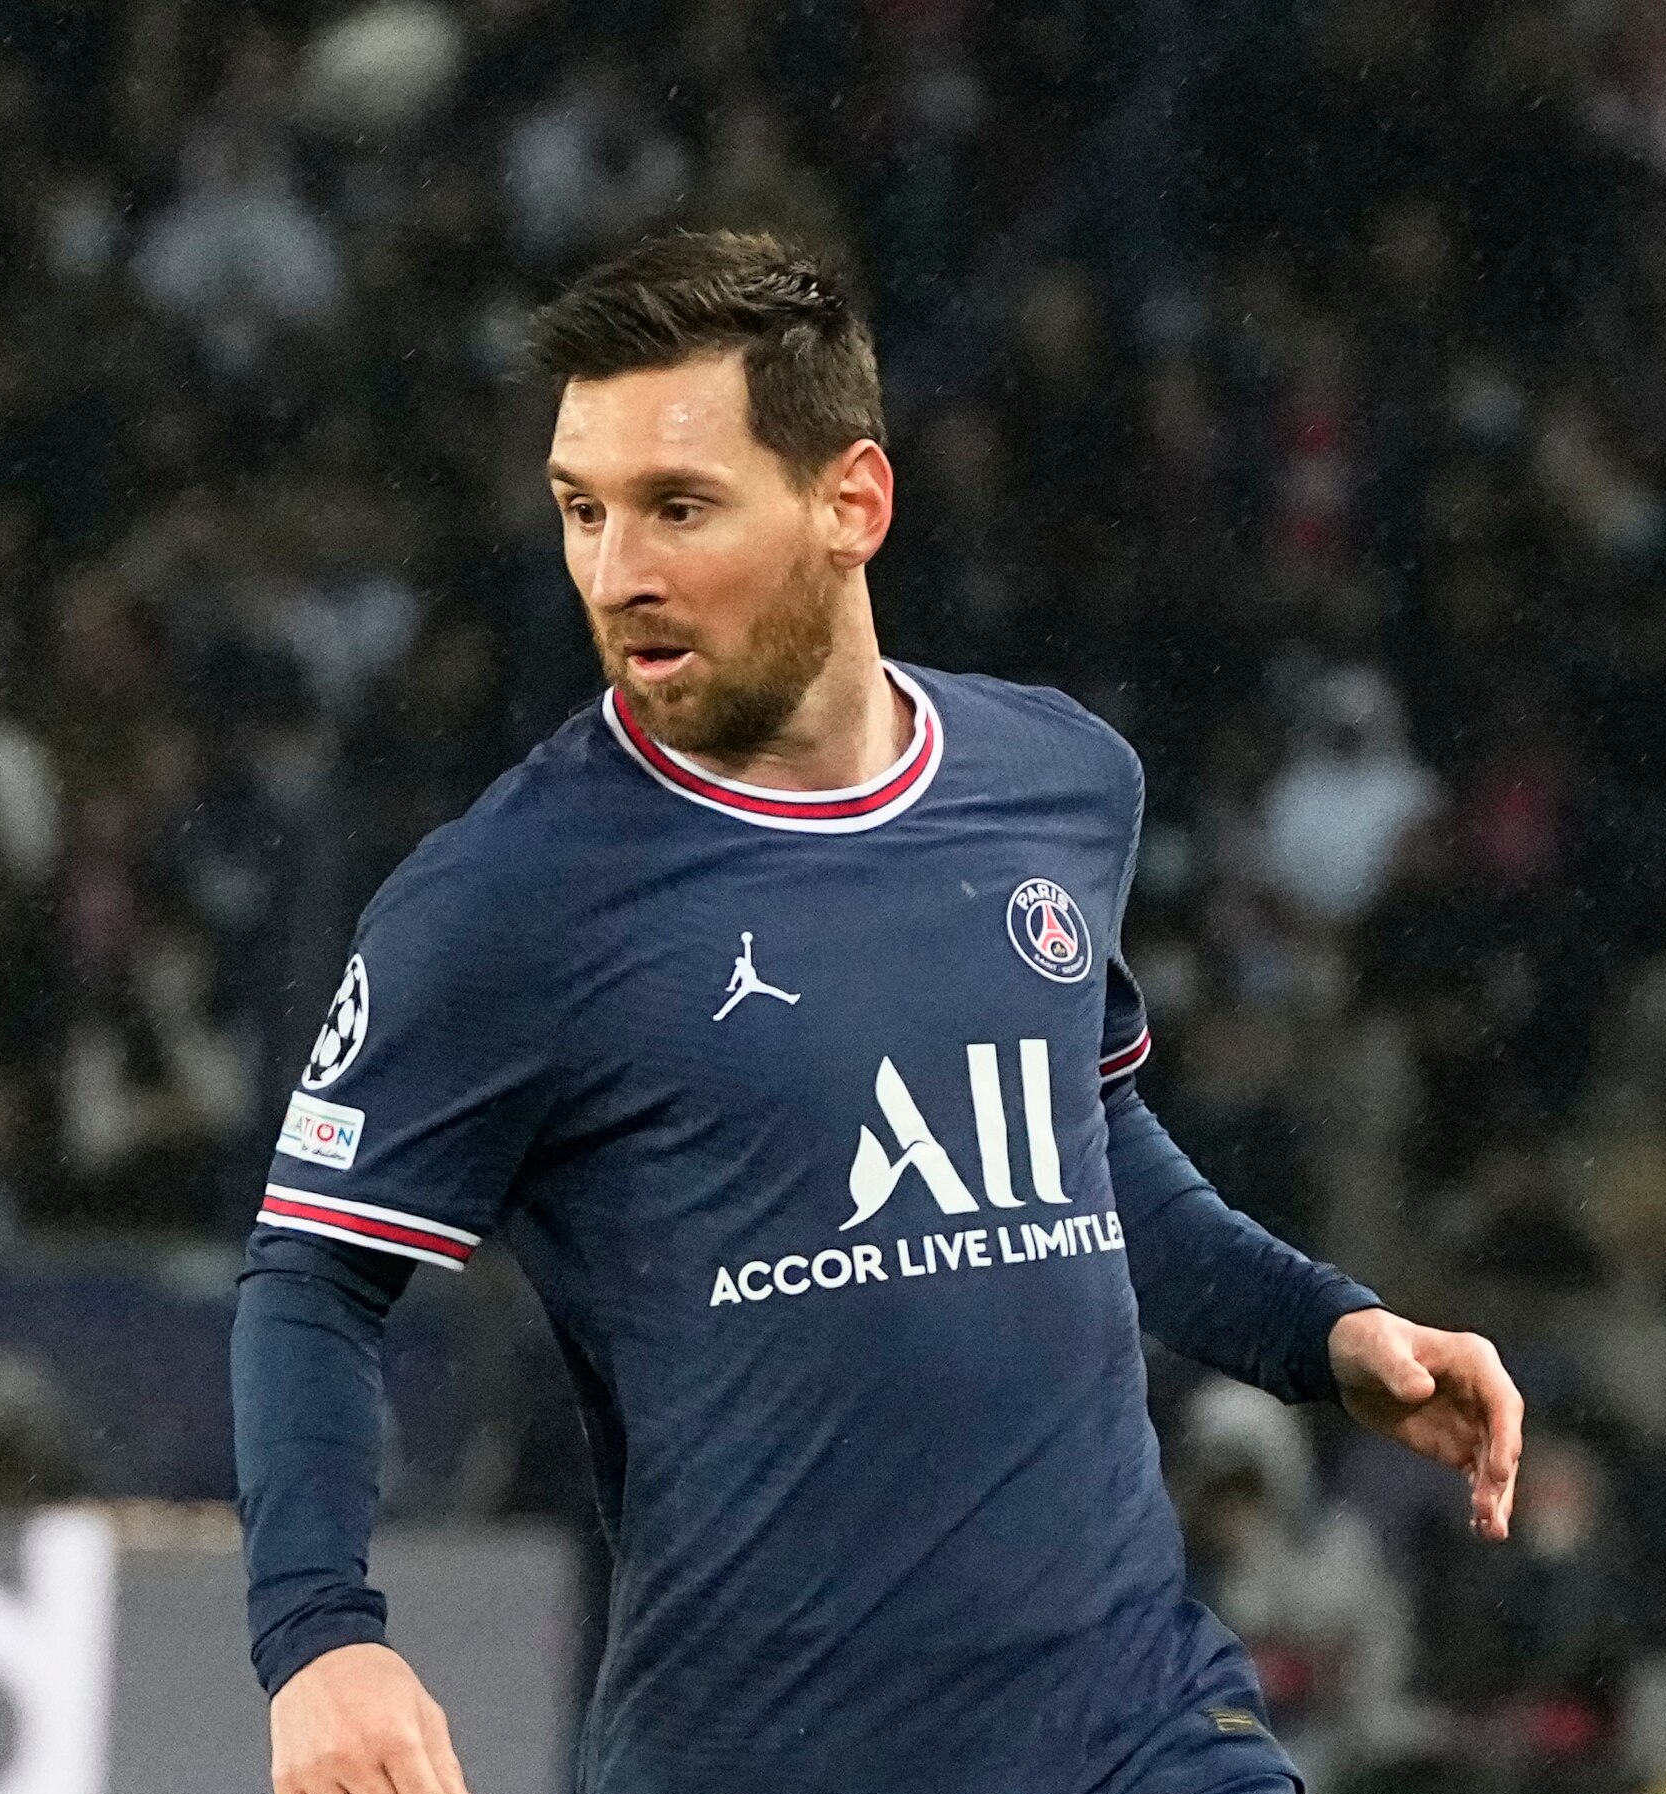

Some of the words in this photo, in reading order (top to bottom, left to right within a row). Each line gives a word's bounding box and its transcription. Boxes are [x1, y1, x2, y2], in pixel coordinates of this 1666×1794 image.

[1015, 883, 1070, 911] PARIS
[709, 1244, 889, 1307] ACCOR
[896, 1229, 993, 1277] LIVE
